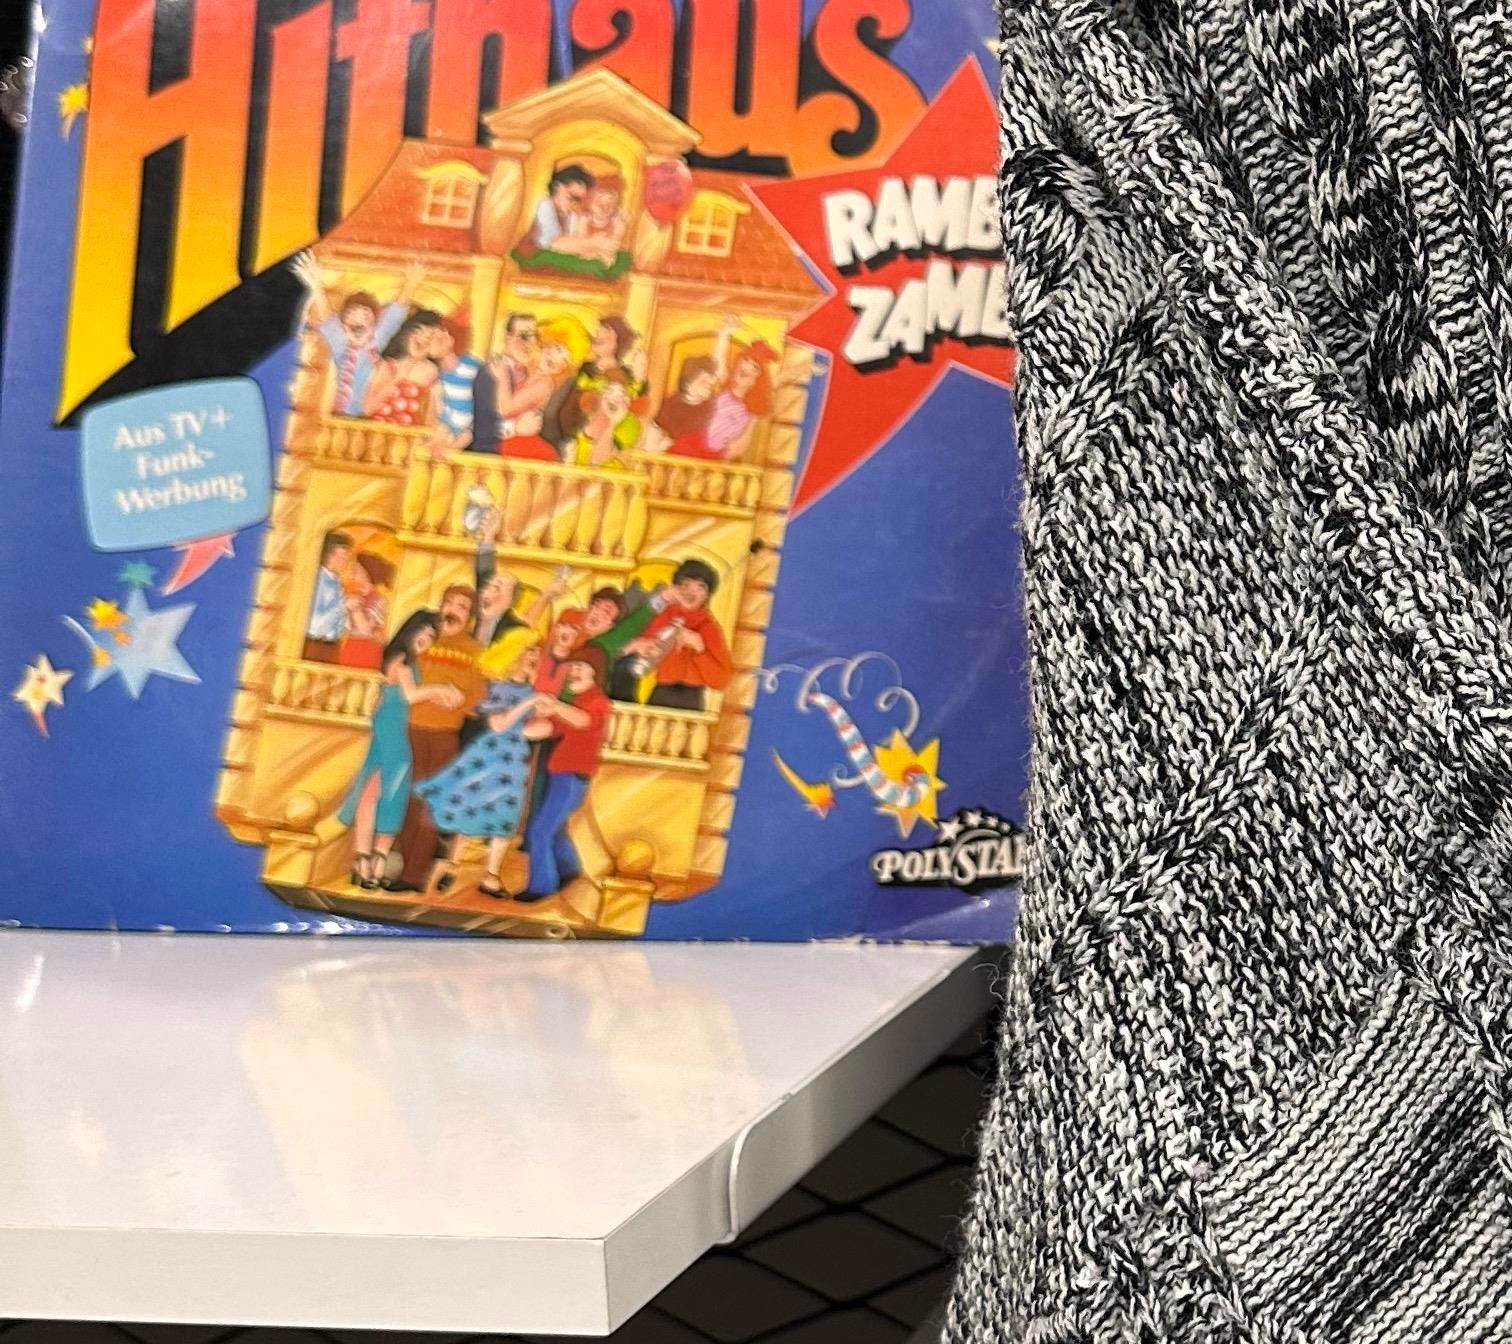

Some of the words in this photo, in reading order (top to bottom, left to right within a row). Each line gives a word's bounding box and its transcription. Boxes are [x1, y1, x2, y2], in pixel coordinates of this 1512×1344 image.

[113, 423, 167, 450] Aus
[136, 442, 215, 480] Funk-
[114, 472, 248, 515] Werbung
